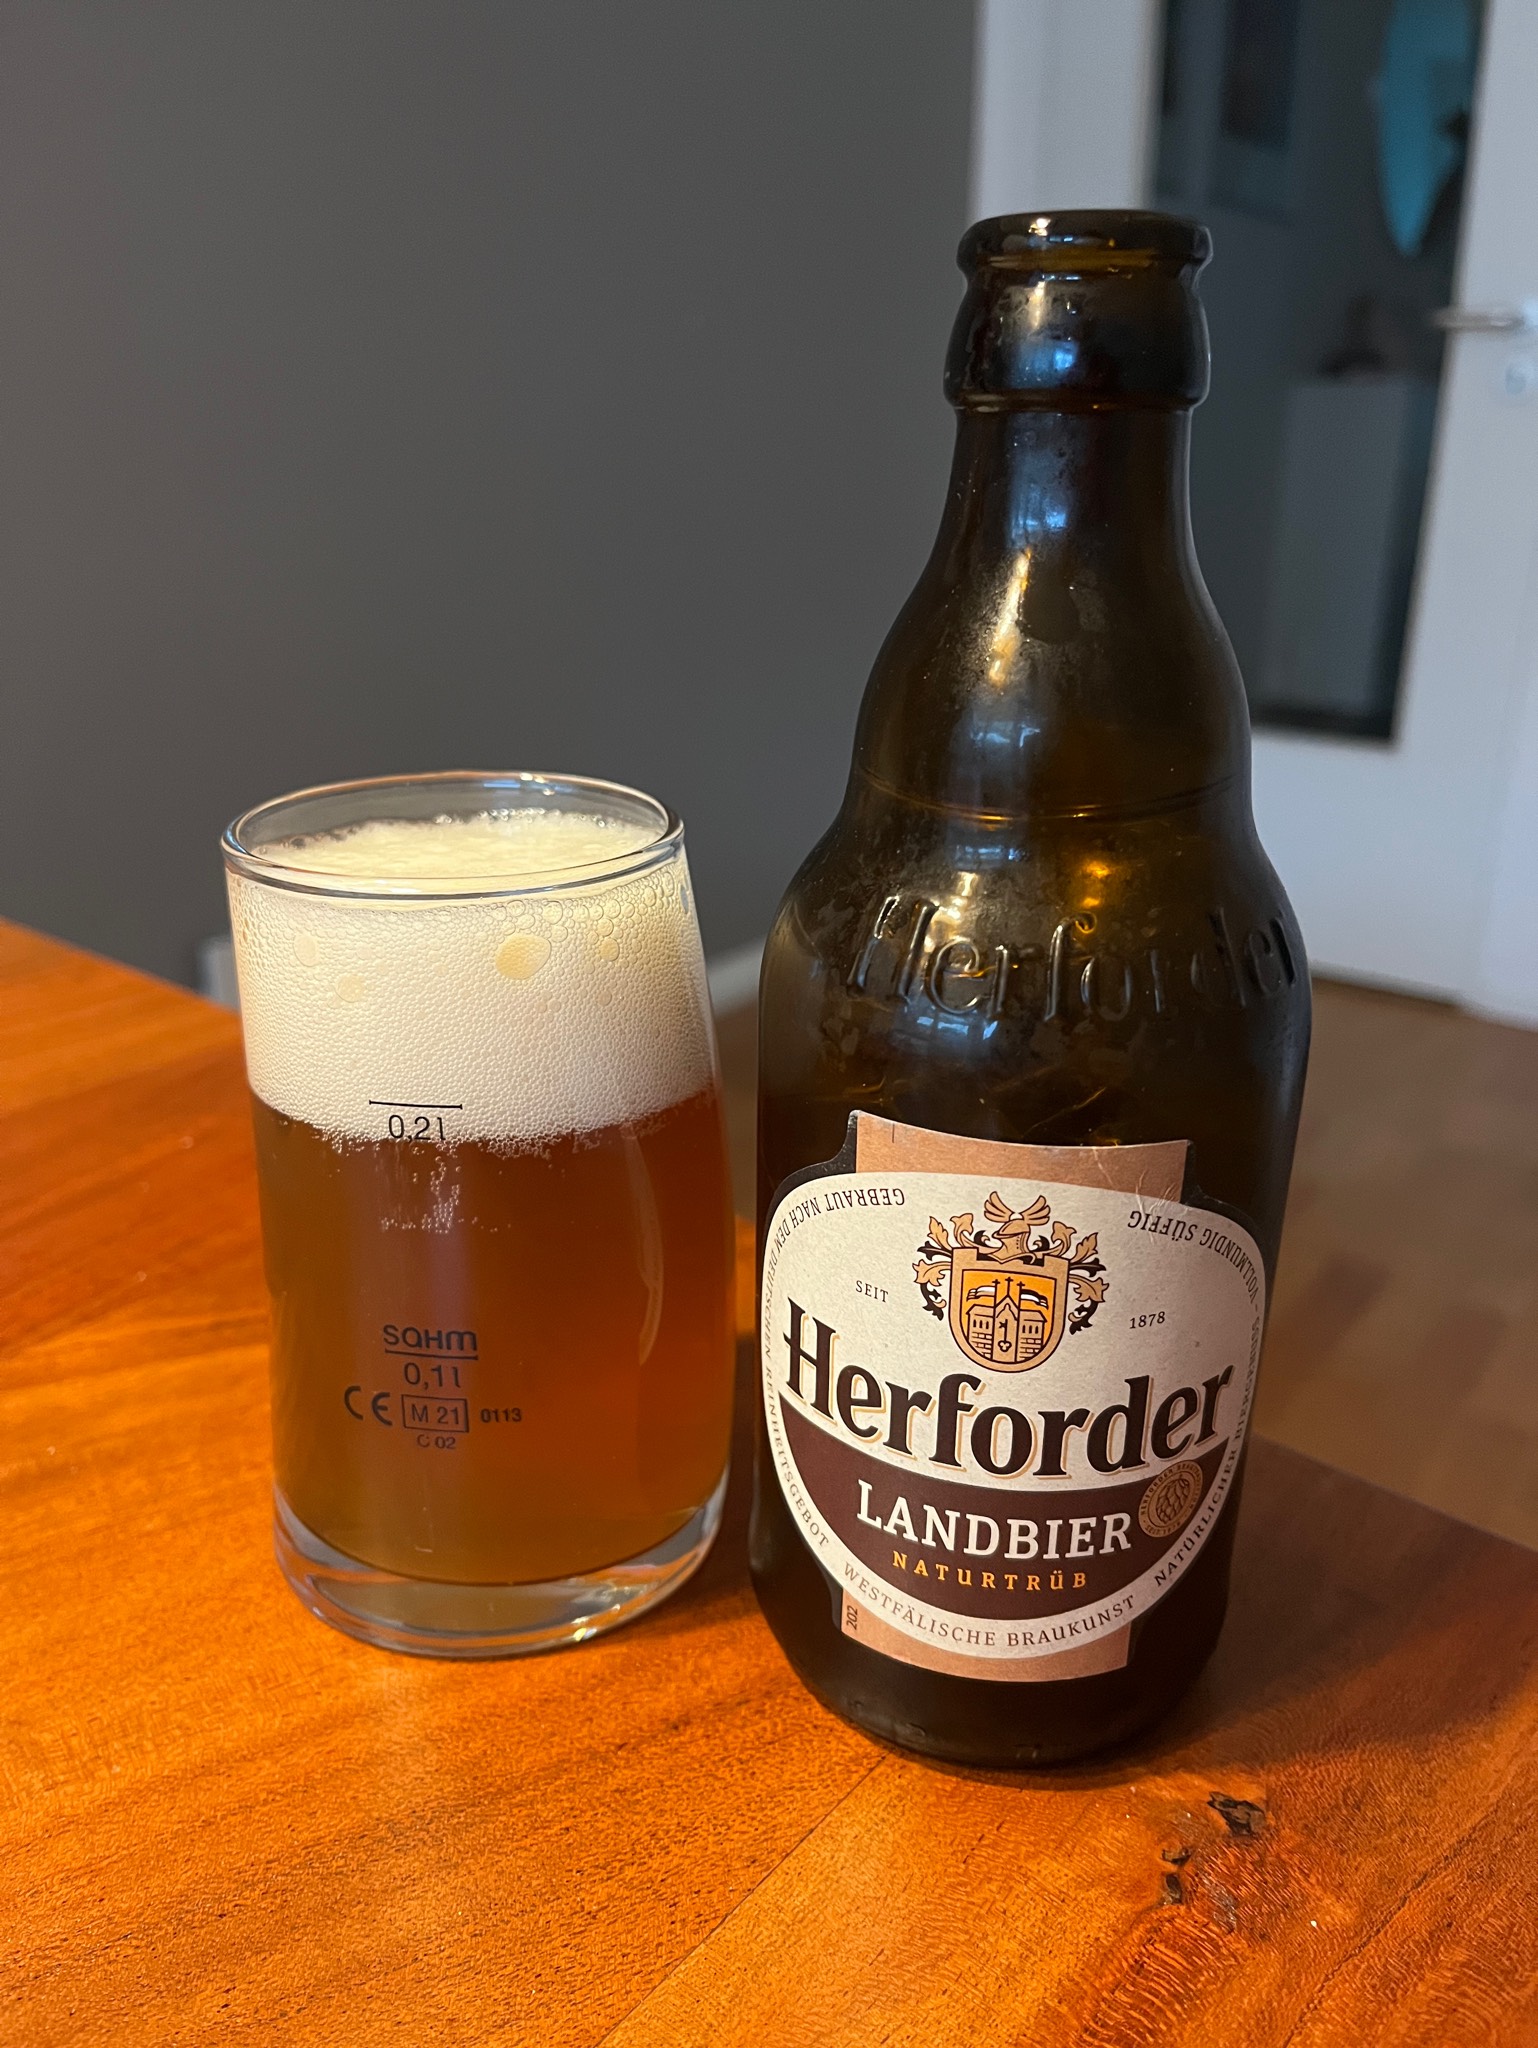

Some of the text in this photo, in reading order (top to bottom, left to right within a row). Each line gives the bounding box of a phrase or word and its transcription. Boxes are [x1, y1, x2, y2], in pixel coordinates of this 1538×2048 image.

[788, 1196, 822, 1229] NACH
[824, 1187, 906, 1212] GEBRAUT
[1127, 1210, 1198, 1242] SÜFFIG
[1199, 1228, 1259, 1305] VOLLMUNDIG
[855, 1280, 1166, 1329] SEIT 1878
[783, 1297, 1236, 1477] Herforder
[411, 1403, 429, 1424] M
[436, 1406, 460, 1425] 21
[480, 1407, 523, 1424] 0113
[765, 1366, 829, 1547] REINHEITSGEBOT
[856, 1479, 1132, 1561] LANDBIER
[1153, 1450, 1239, 1587] NATÜRLICHER
[892, 1550, 1087, 1591] NATURTRÜB
[844, 1561, 1135, 1648] WESTFÄLISCHE BRAUKUNST
[846, 1605, 858, 1631] 202
